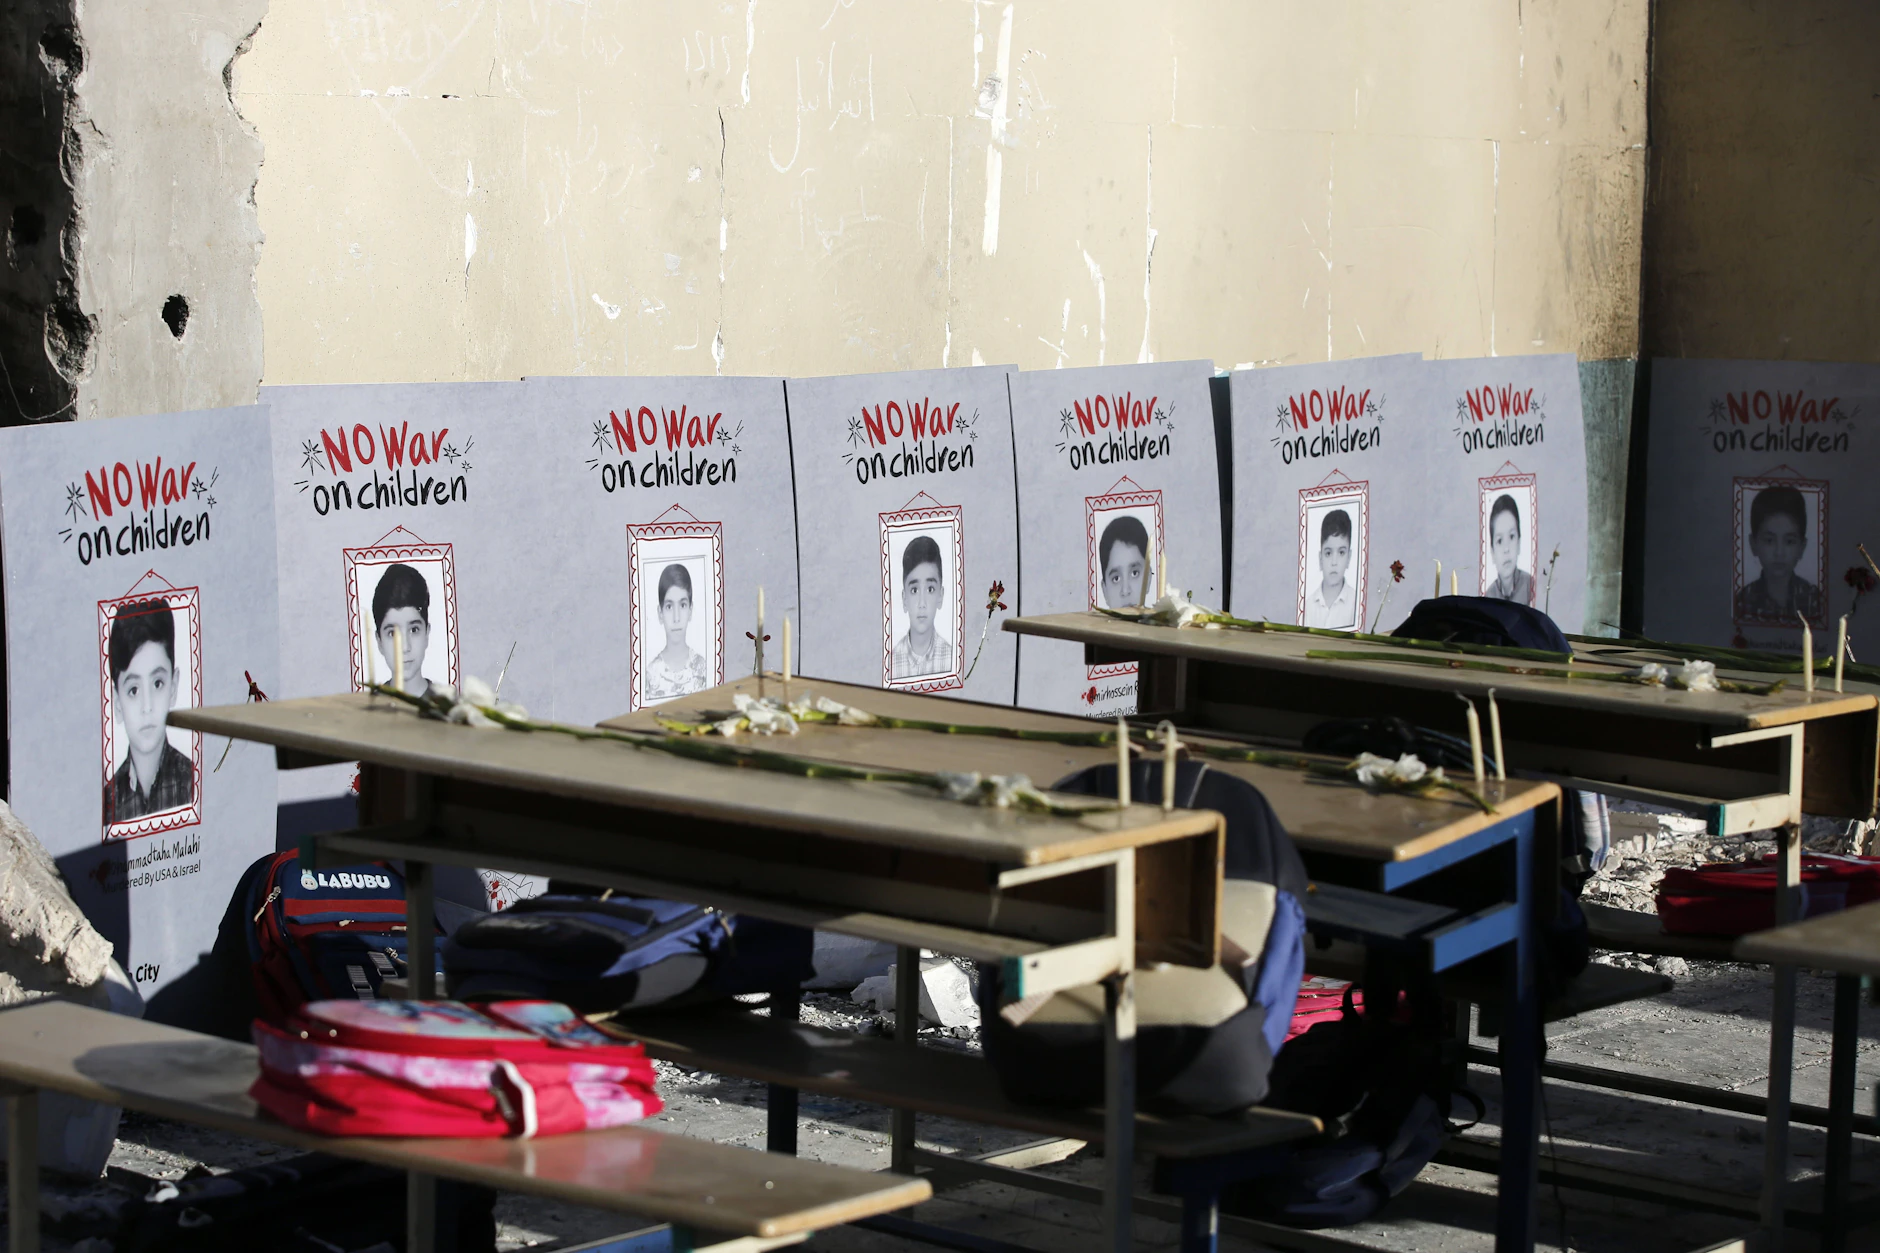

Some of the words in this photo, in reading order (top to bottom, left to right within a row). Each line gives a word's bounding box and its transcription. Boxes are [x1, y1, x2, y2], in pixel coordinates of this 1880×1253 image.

[862, 400, 905, 448] NO
[907, 397, 960, 441] War
[1073, 395, 1111, 436] NO
[1114, 391, 1158, 431] War
[1289, 390, 1324, 430] NO
[1328, 386, 1371, 425] War
[1466, 386, 1494, 421] NO
[1499, 383, 1533, 419] War
[1726, 390, 1772, 425] NO
[1778, 389, 1840, 425] War
[320, 423, 375, 476] NO
[380, 420, 449, 471] War
[610, 406, 658, 455] NO
[662, 404, 723, 451] War
[1069, 442, 1096, 471] on
[1099, 430, 1170, 464] children
[1283, 436, 1307, 465] on
[1310, 424, 1380, 458] children
[1463, 428, 1484, 454] on
[1486, 420, 1544, 449] children
[1713, 431, 1746, 453] on
[1750, 424, 1849, 453] children
[601, 460, 636, 493] on
[640, 450, 737, 488] children
[857, 453, 887, 485] on
[889, 440, 974, 478] children
[85, 461, 133, 520] NO
[137, 455, 197, 512] War
[314, 481, 353, 516] on
[357, 469, 467, 510] children
[78, 526, 112, 566] on
[115, 509, 210, 555] children
[173, 833, 201, 860] Malahi
[101, 872, 144, 895] Murdered
[144, 872, 155, 888] By
[155, 867, 172, 883] USA
[172, 865, 180, 880] &
[180, 860, 201, 877] Israel
[319, 873, 391, 889] LABUBU
[135, 962, 160, 984] City
